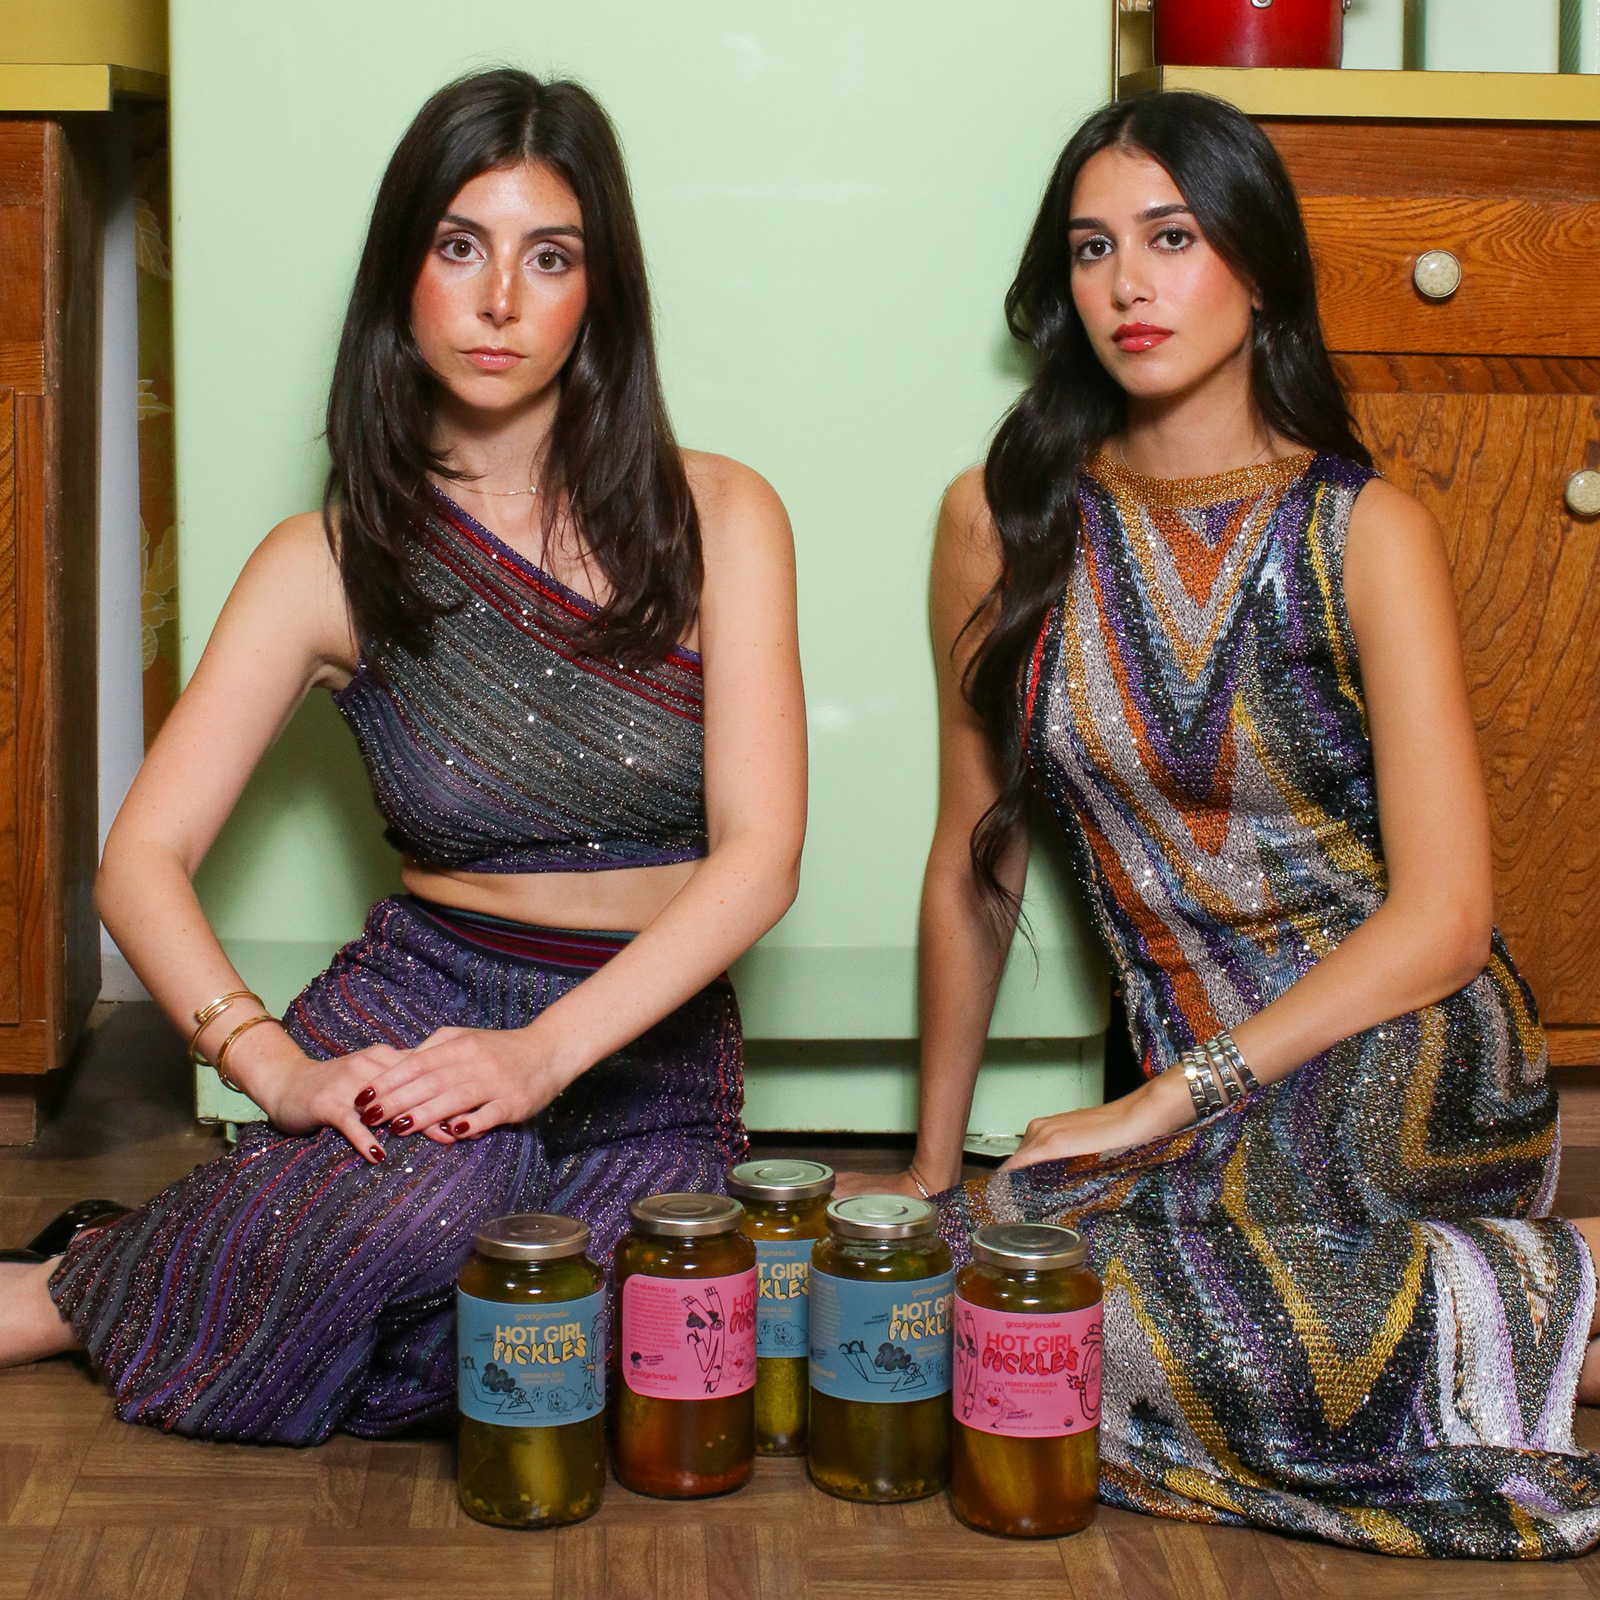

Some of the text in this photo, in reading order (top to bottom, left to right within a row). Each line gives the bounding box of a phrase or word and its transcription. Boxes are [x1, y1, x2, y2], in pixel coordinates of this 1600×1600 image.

[639, 1284, 659, 1292] HEARD
[892, 1300, 932, 1322] HOT
[496, 1325, 539, 1344] HOT
[544, 1322, 585, 1343] GIRL
[986, 1331, 1077, 1354] HOT GIRL
[492, 1336, 587, 1366] PICKLES
[982, 1347, 1080, 1376] PICKLES
[1029, 1380, 1058, 1388] HARISSA
